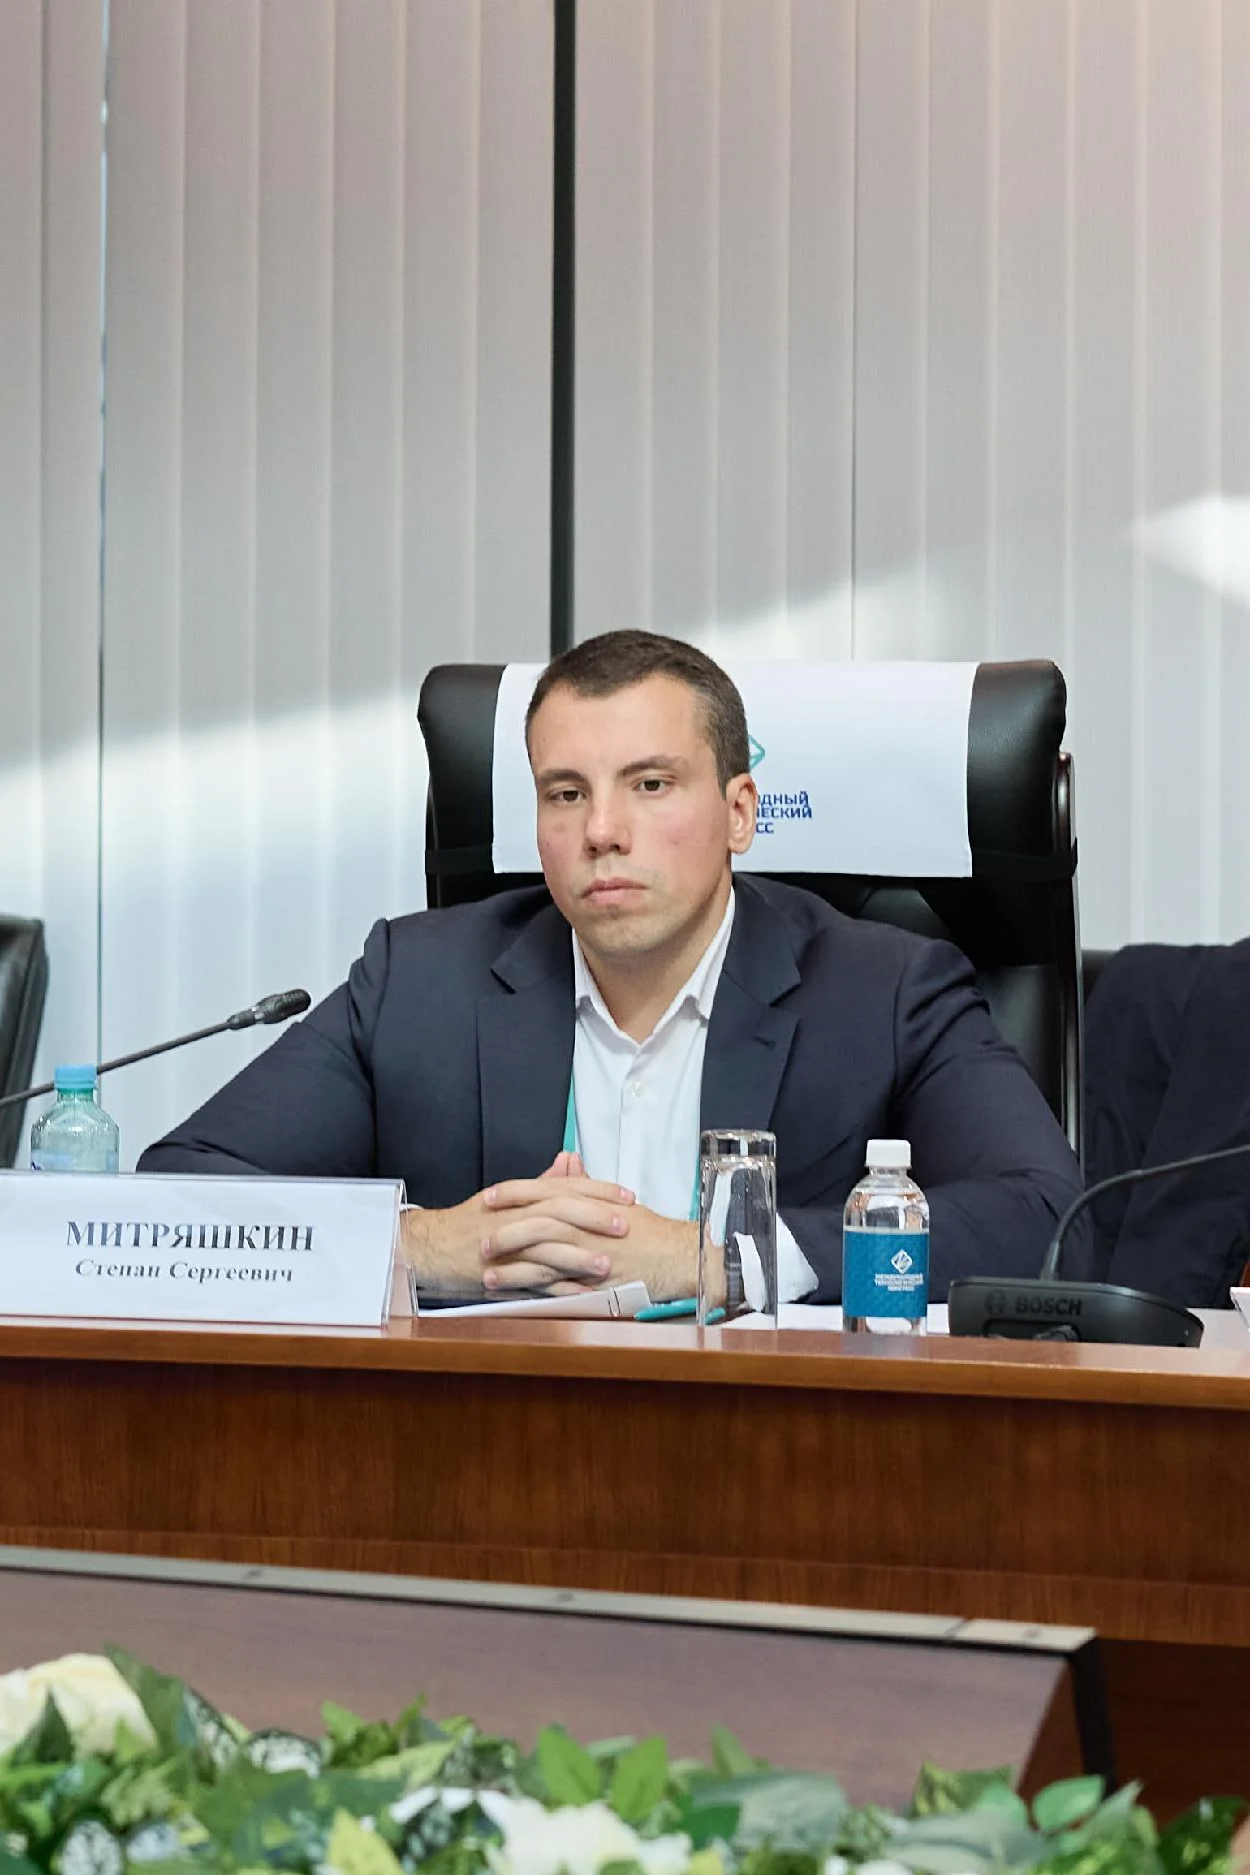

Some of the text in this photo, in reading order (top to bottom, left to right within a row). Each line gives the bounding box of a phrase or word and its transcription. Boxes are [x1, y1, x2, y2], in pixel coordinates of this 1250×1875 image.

[758, 791, 809, 806] ДНЫЙ
[756, 822, 775, 834] СС
[66, 1220, 314, 1251] МИТРЯШКИН
[75, 1259, 293, 1284] Степан Сергеевич
[1016, 1298, 1082, 1317] BOSCH
